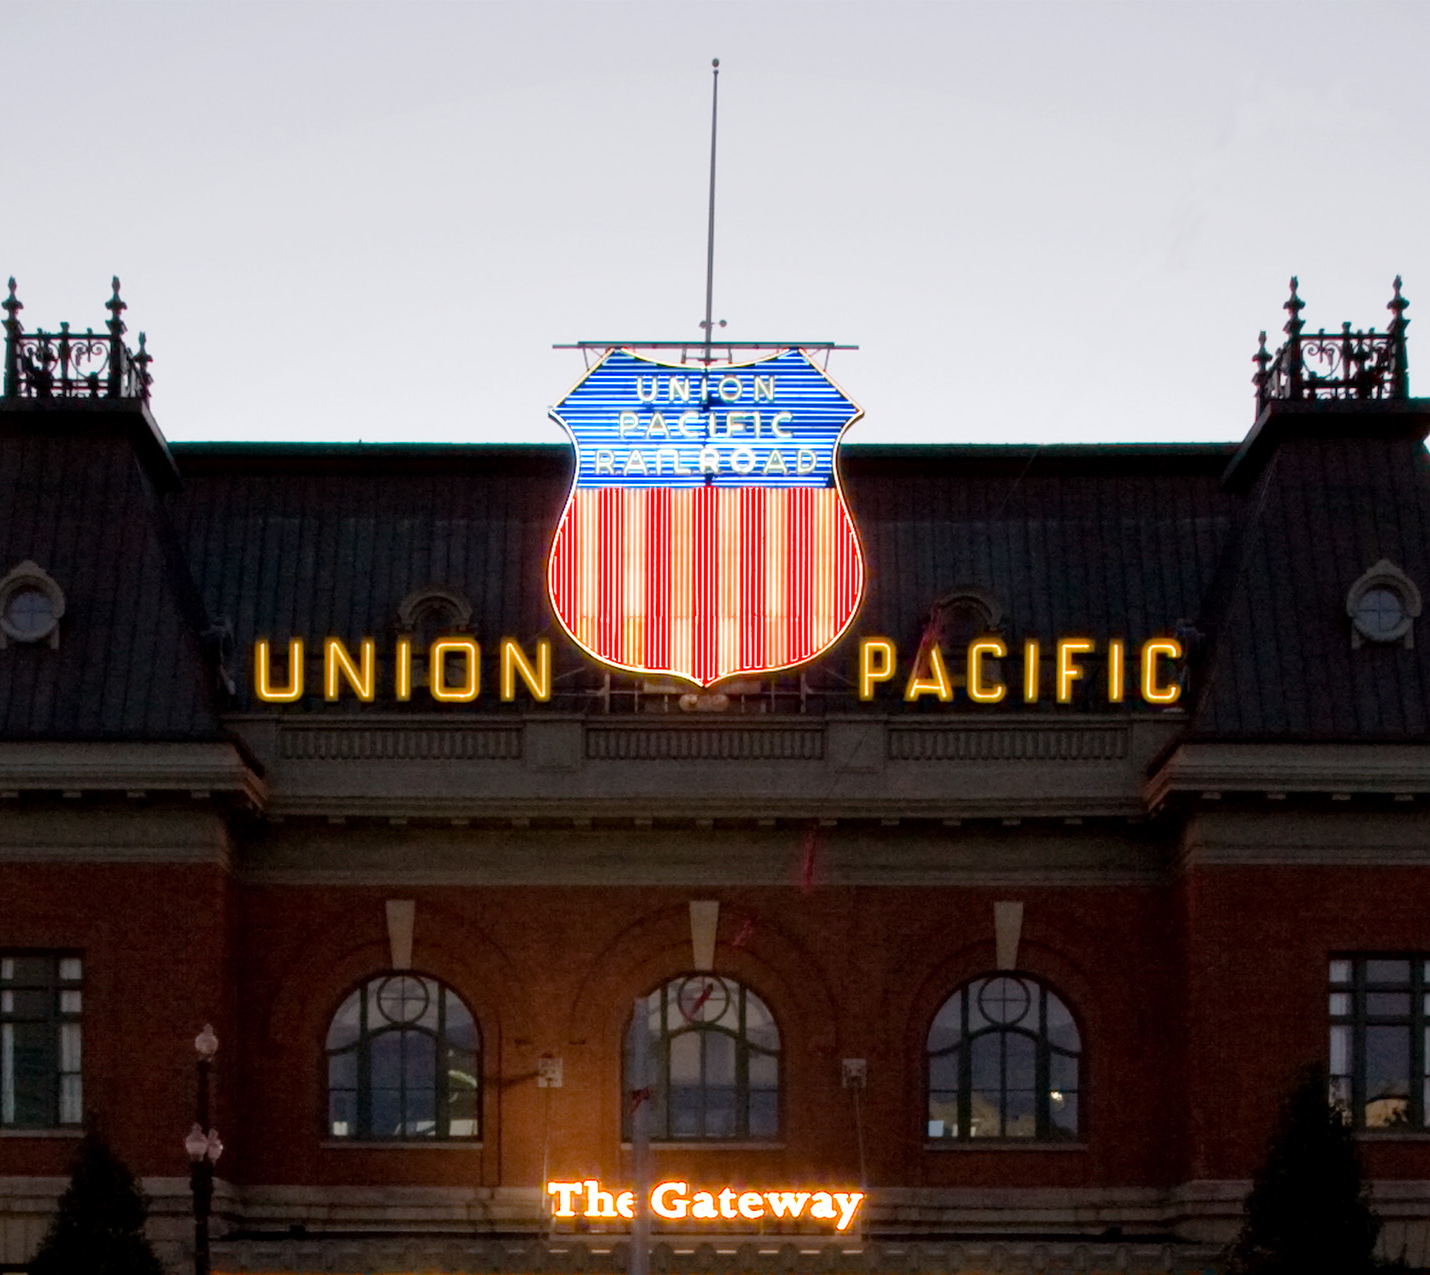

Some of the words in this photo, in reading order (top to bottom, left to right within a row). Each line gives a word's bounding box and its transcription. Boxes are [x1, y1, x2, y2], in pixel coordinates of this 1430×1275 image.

[635, 374, 776, 403] UNION
[618, 411, 795, 439] PACIFIC
[593, 448, 819, 476] RAILROAD
[255, 637, 551, 702] UNION
[859, 637, 1183, 703] PACIFIC
[547, 1179, 636, 1219] The
[650, 1181, 865, 1231] Gateway
